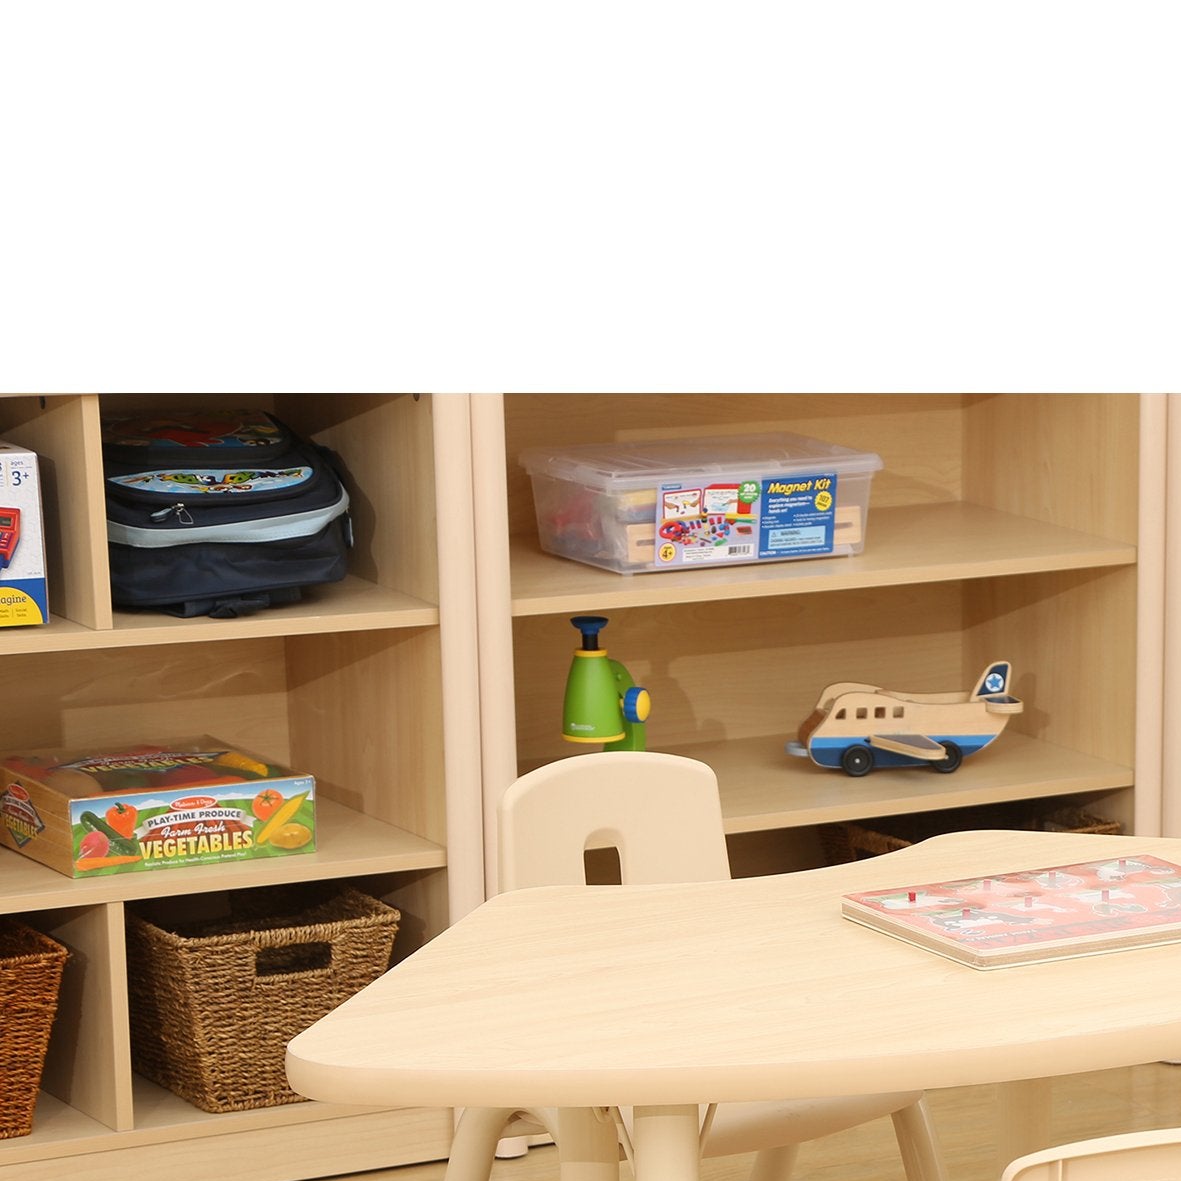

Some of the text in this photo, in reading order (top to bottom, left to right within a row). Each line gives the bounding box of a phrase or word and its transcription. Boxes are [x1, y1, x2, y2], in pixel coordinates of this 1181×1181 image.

[11, 470, 30, 487] 3+
[767, 480, 813, 496] Magnet
[814, 478, 832, 491] Kit
[743, 483, 757, 493] 20
[0, 594, 27, 606] agine
[4, 814, 38, 840] EGETABLES
[147, 809, 242, 828] PLAY-TIME PRODUCE
[160, 820, 226, 839] Farm Fresh
[139, 830, 253, 860] VEGETABLES
